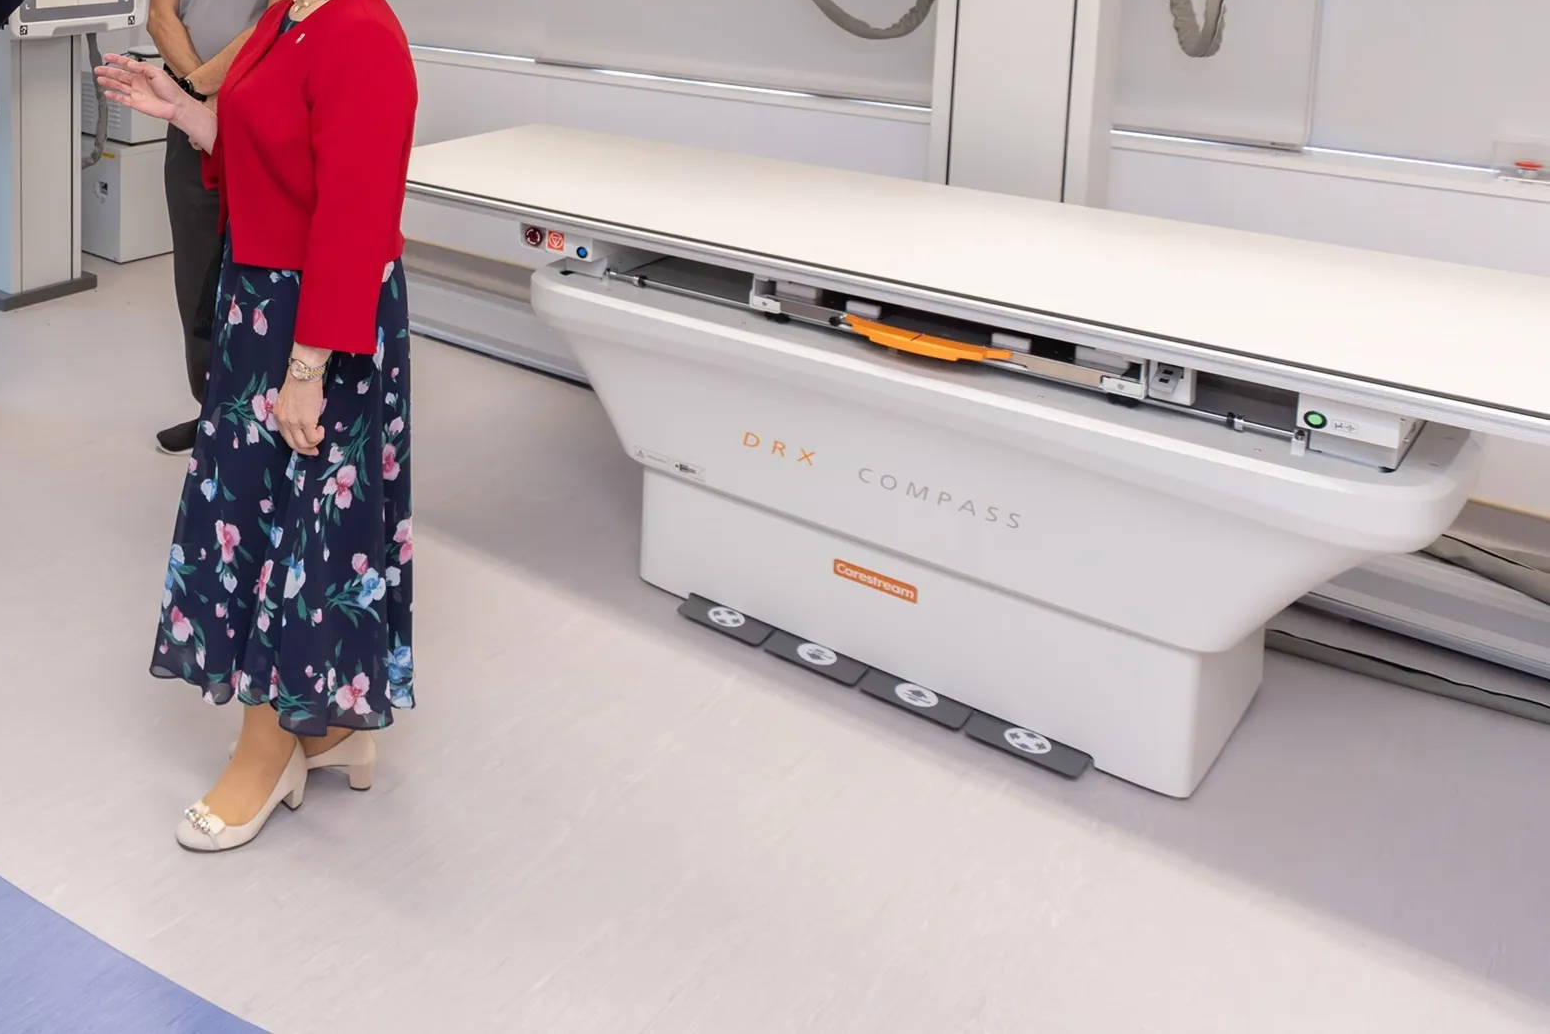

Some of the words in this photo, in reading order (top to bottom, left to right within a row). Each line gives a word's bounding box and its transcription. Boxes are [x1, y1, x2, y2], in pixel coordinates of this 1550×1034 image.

[742, 432, 816, 466] DRX
[858, 467, 1021, 529] COMPASS
[836, 562, 915, 600] Carestream
